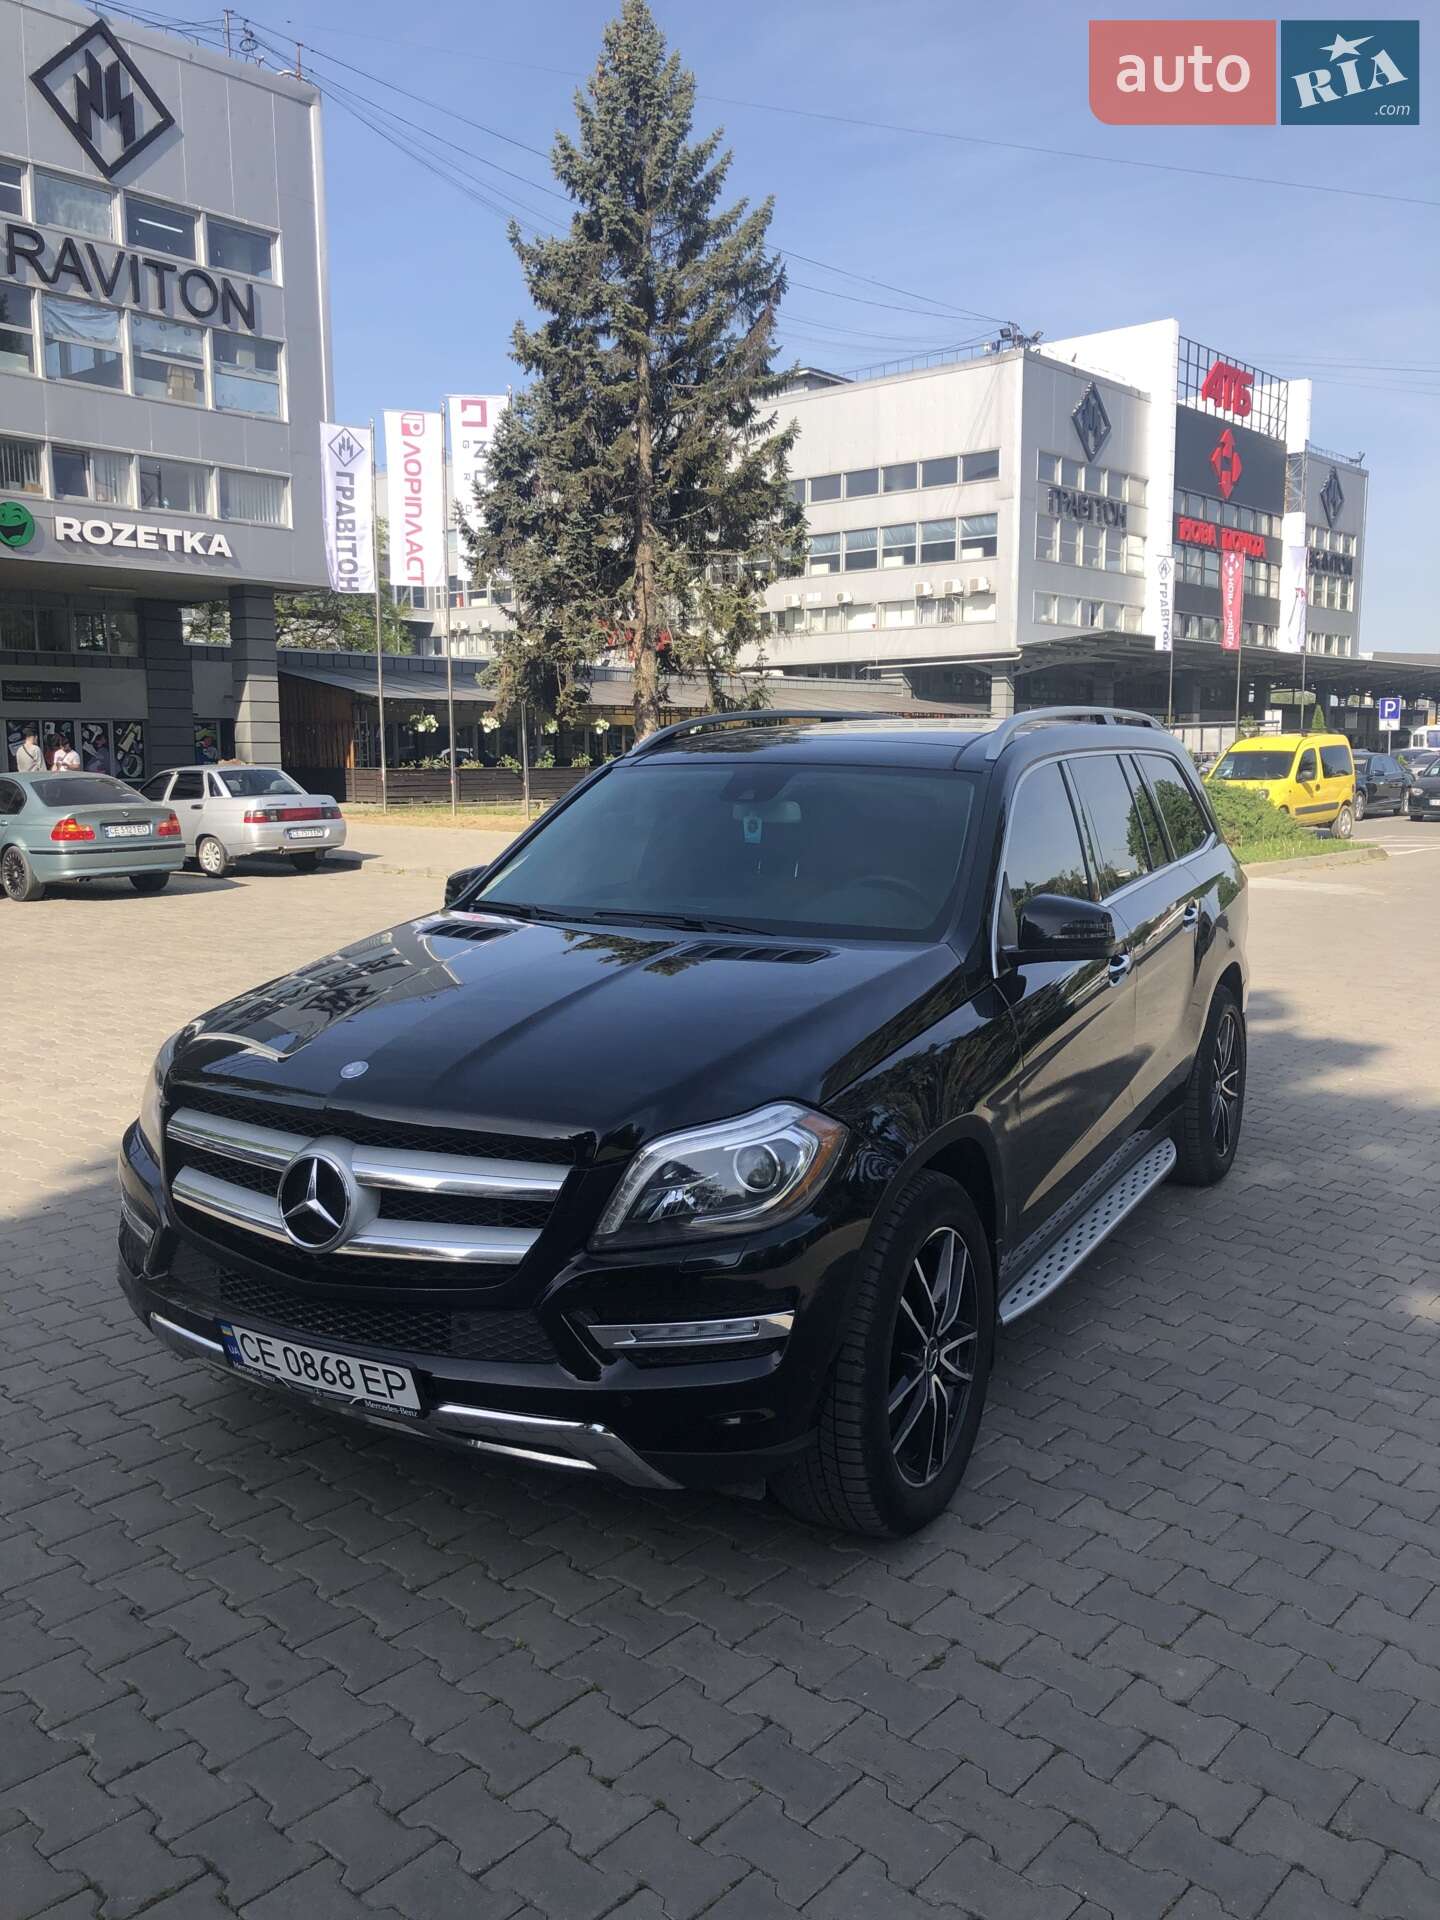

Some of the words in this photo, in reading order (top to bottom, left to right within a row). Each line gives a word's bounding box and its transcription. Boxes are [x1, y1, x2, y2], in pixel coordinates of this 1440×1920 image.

[6, 223, 256, 330] RAVITON
[1201, 360, 1256, 418] АТБ
[54, 514, 233, 559] ROZETKA
[335, 470, 360, 592] ГРАВІТОН
[1384, 700, 1396, 718] P
[228, 1344, 241, 1355] UA
[240, 1333, 281, 1372] CE
[282, 1345, 356, 1390] 0868
[359, 1363, 407, 1399] EP
[364, 1399, 418, 1417] Mercedes-Benz
